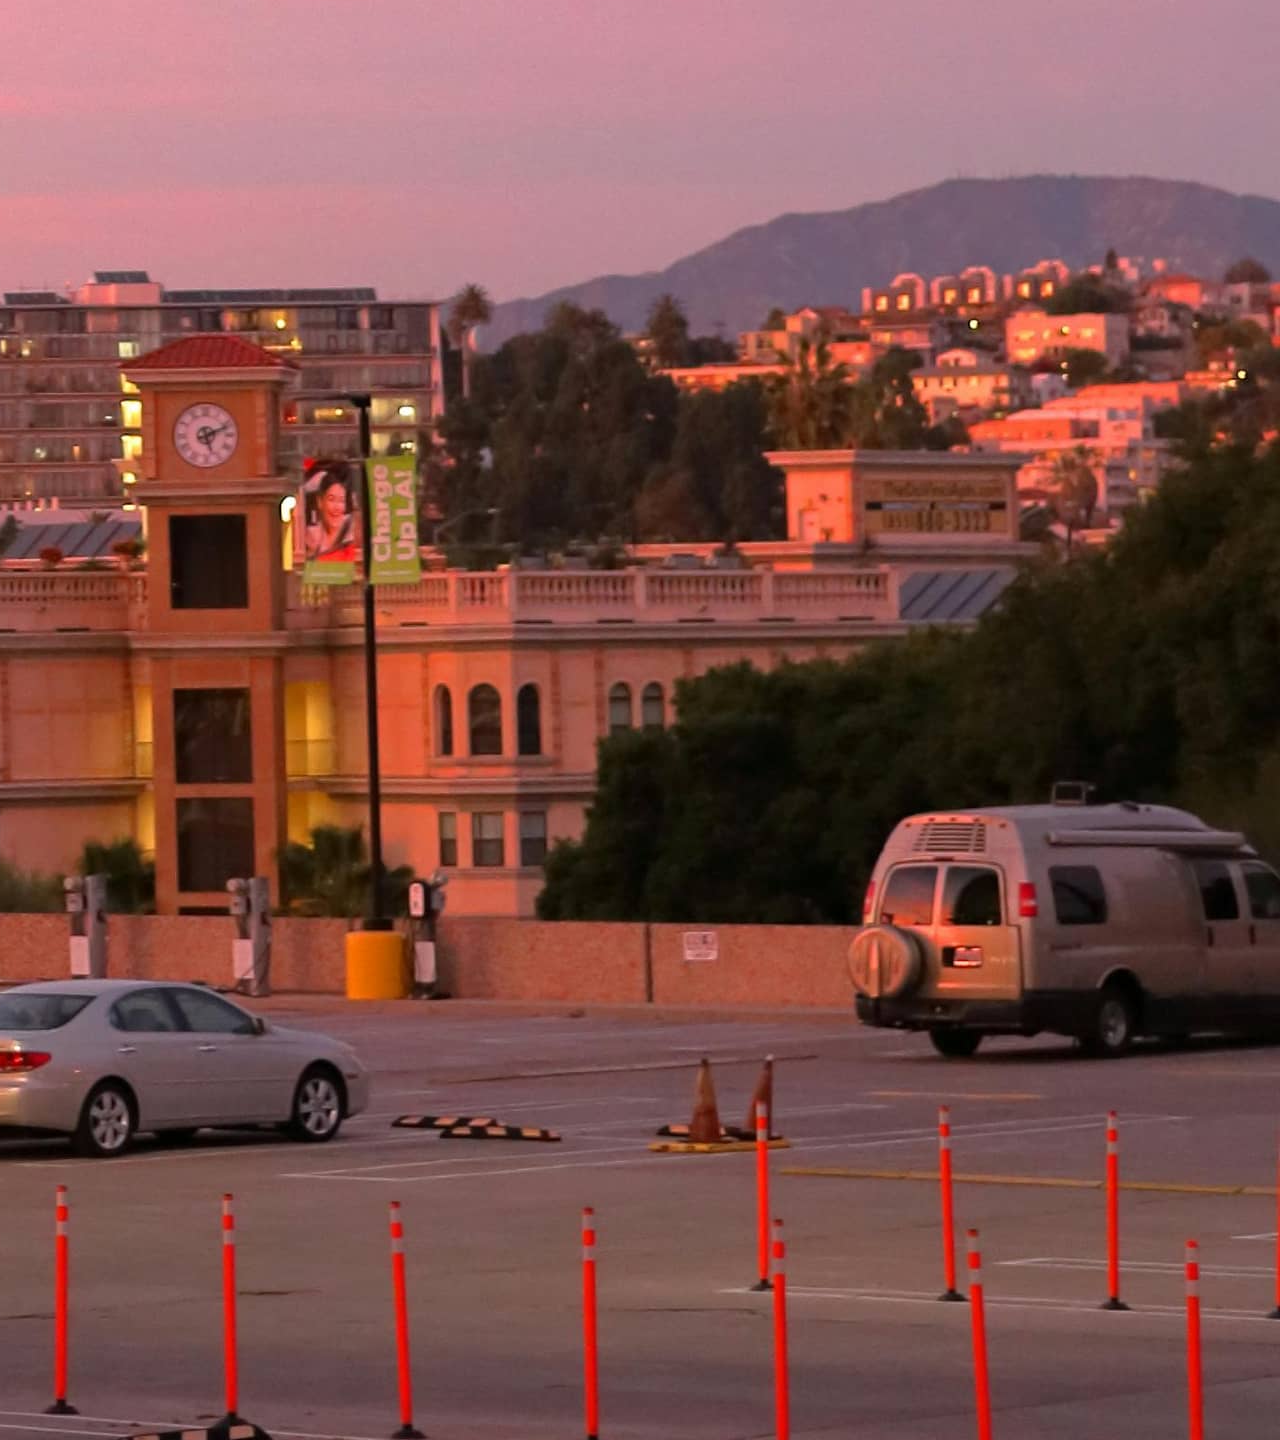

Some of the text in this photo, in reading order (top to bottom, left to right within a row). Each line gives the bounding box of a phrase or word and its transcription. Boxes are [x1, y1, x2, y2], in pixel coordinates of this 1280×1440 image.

[371, 464, 394, 562] Charge
[393, 470, 418, 561] Up LA!
